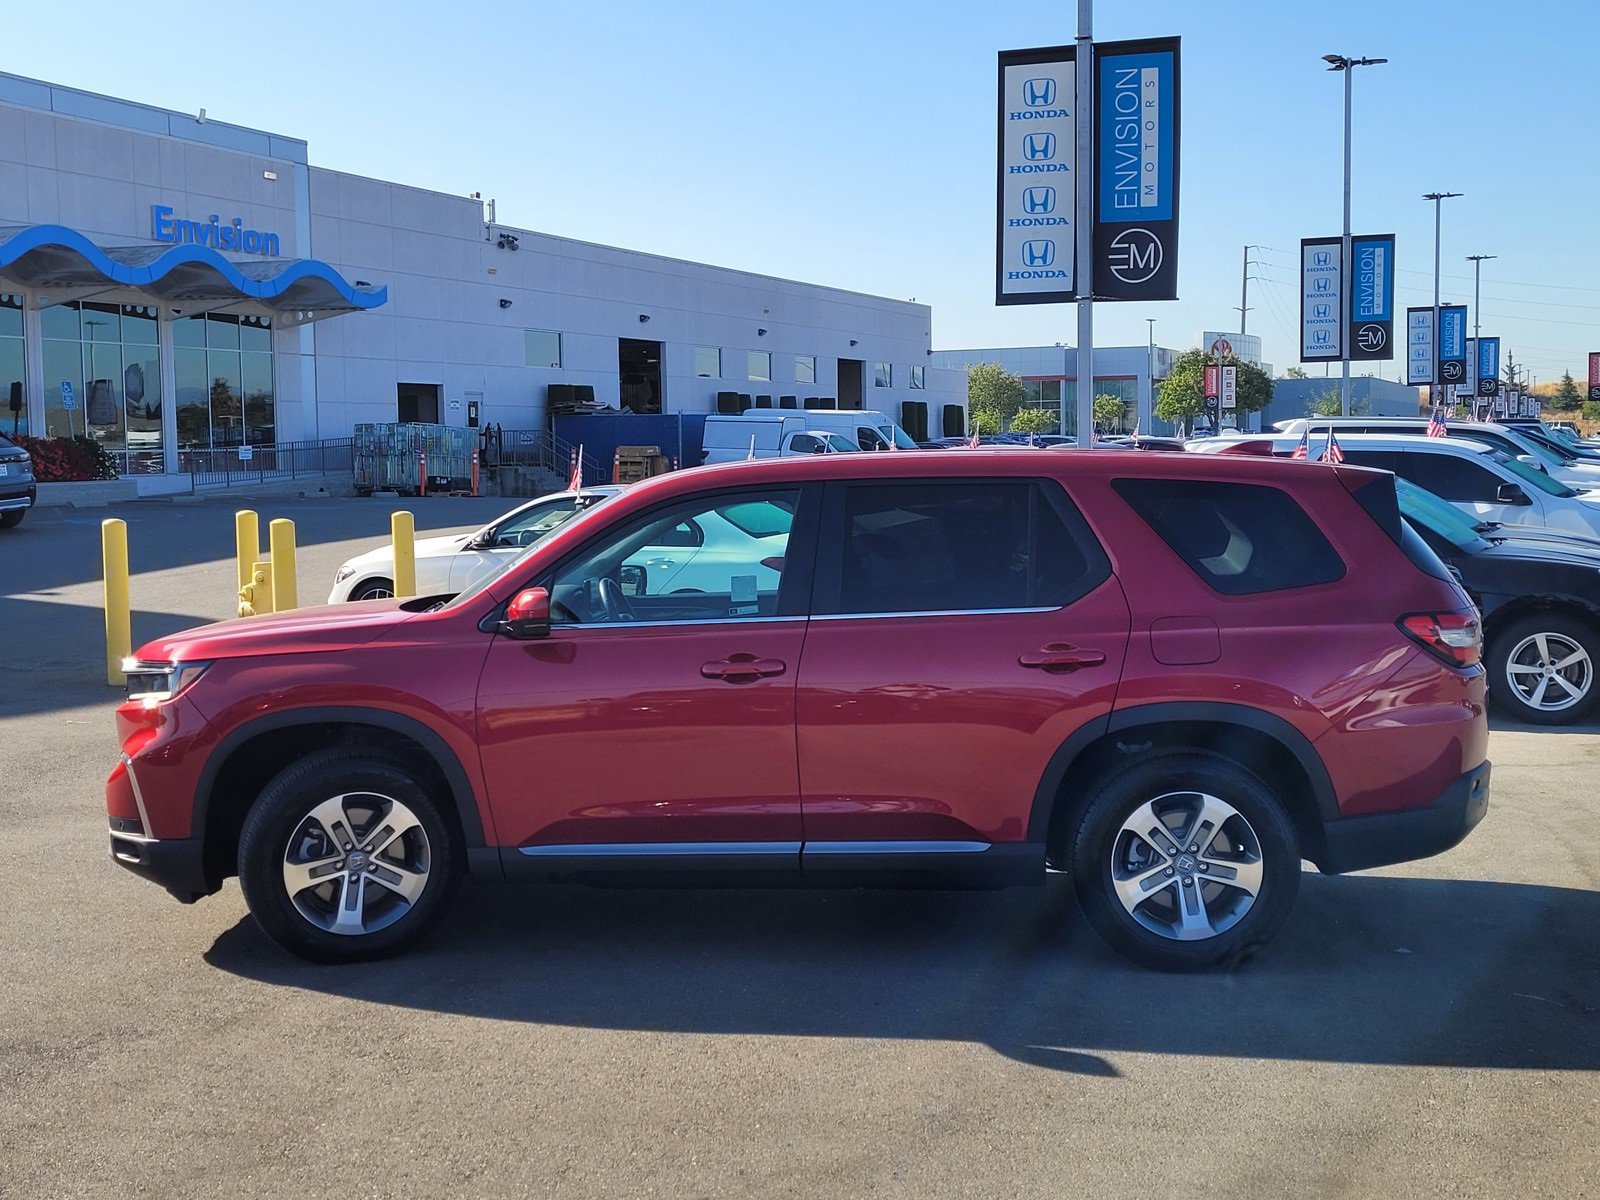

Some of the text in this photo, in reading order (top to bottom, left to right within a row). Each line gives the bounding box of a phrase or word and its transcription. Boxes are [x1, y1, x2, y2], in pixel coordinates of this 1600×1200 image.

[1009, 109, 1070, 120] HONDA
[1114, 67, 1139, 209] ENVISION
[1144, 81, 1156, 196] MOTORS
[1008, 163, 1070, 174] HONDA
[150, 204, 280, 256] Envision
[1008, 217, 1069, 227] HONDA
[1360, 247, 1374, 316] ENVISION
[1444, 313, 1454, 357] ENVISION
